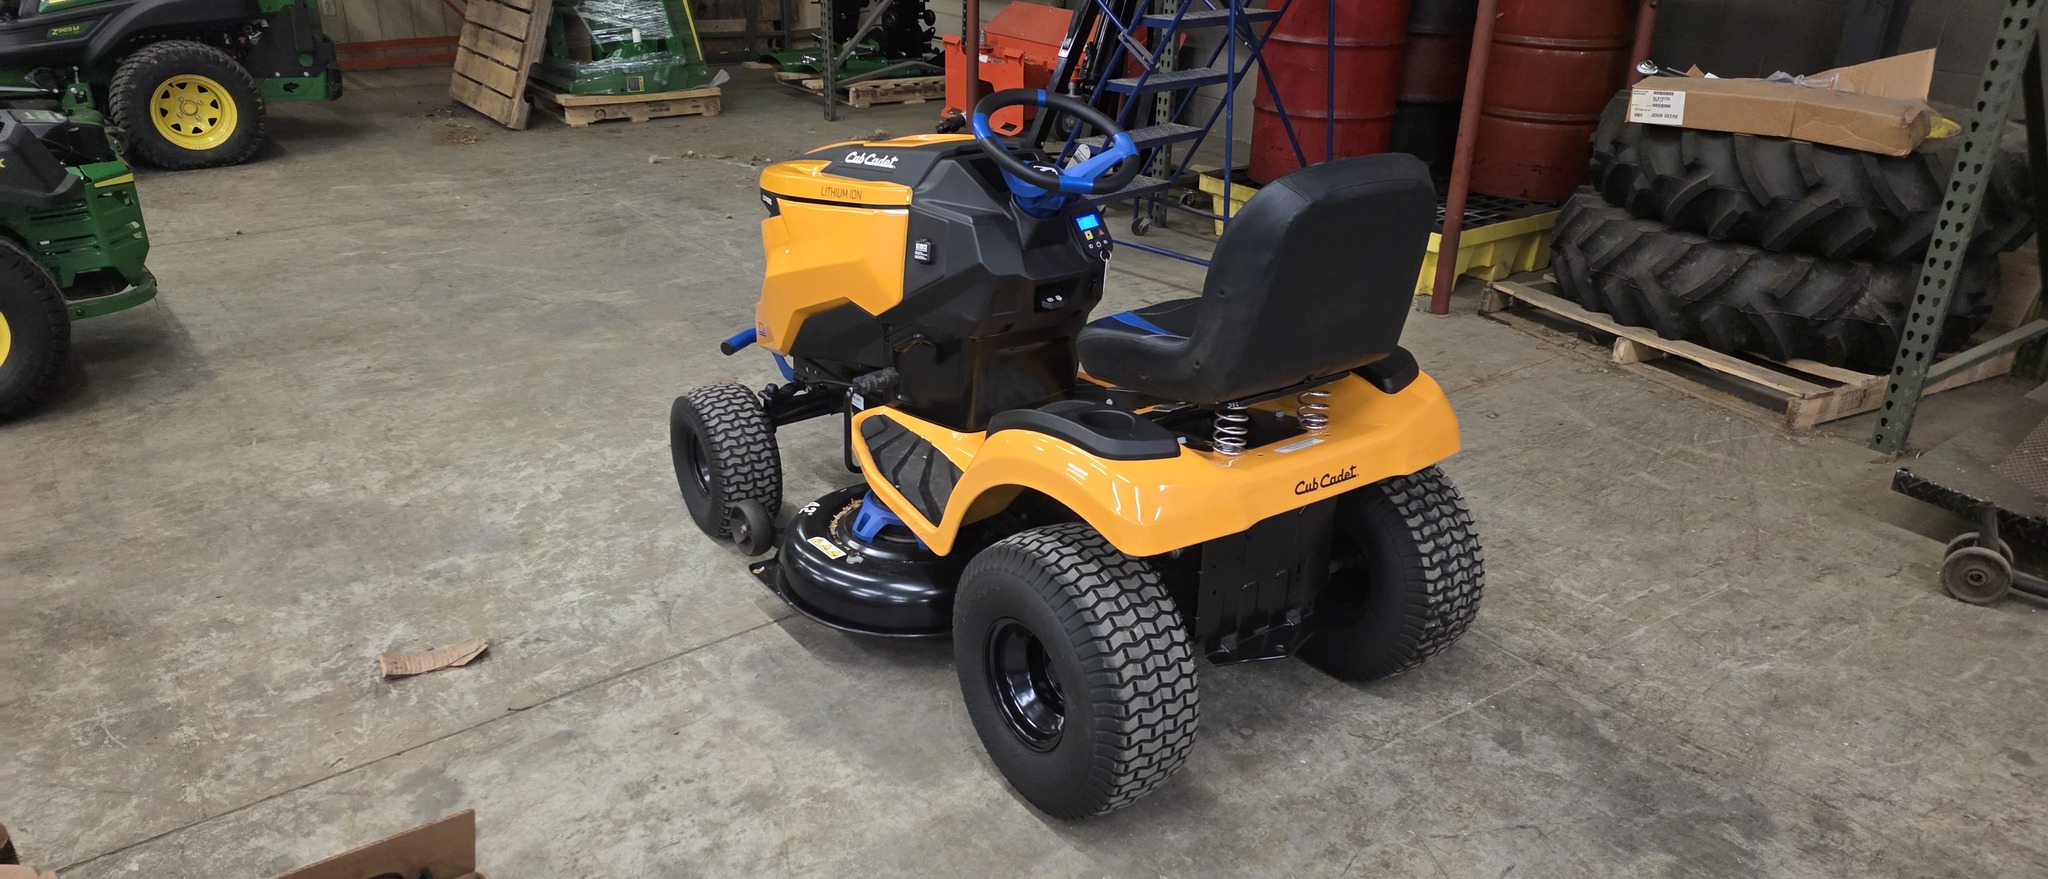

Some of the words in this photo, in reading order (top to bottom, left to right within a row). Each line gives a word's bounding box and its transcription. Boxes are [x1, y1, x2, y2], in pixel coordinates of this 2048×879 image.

[845, 151, 864, 164] Cub
[864, 153, 899, 168] Cadet
[821, 186, 848, 198] LITHIUM
[849, 189, 863, 200] ION
[1295, 477, 1319, 495] Cub
[1320, 465, 1357, 488] Cadet
